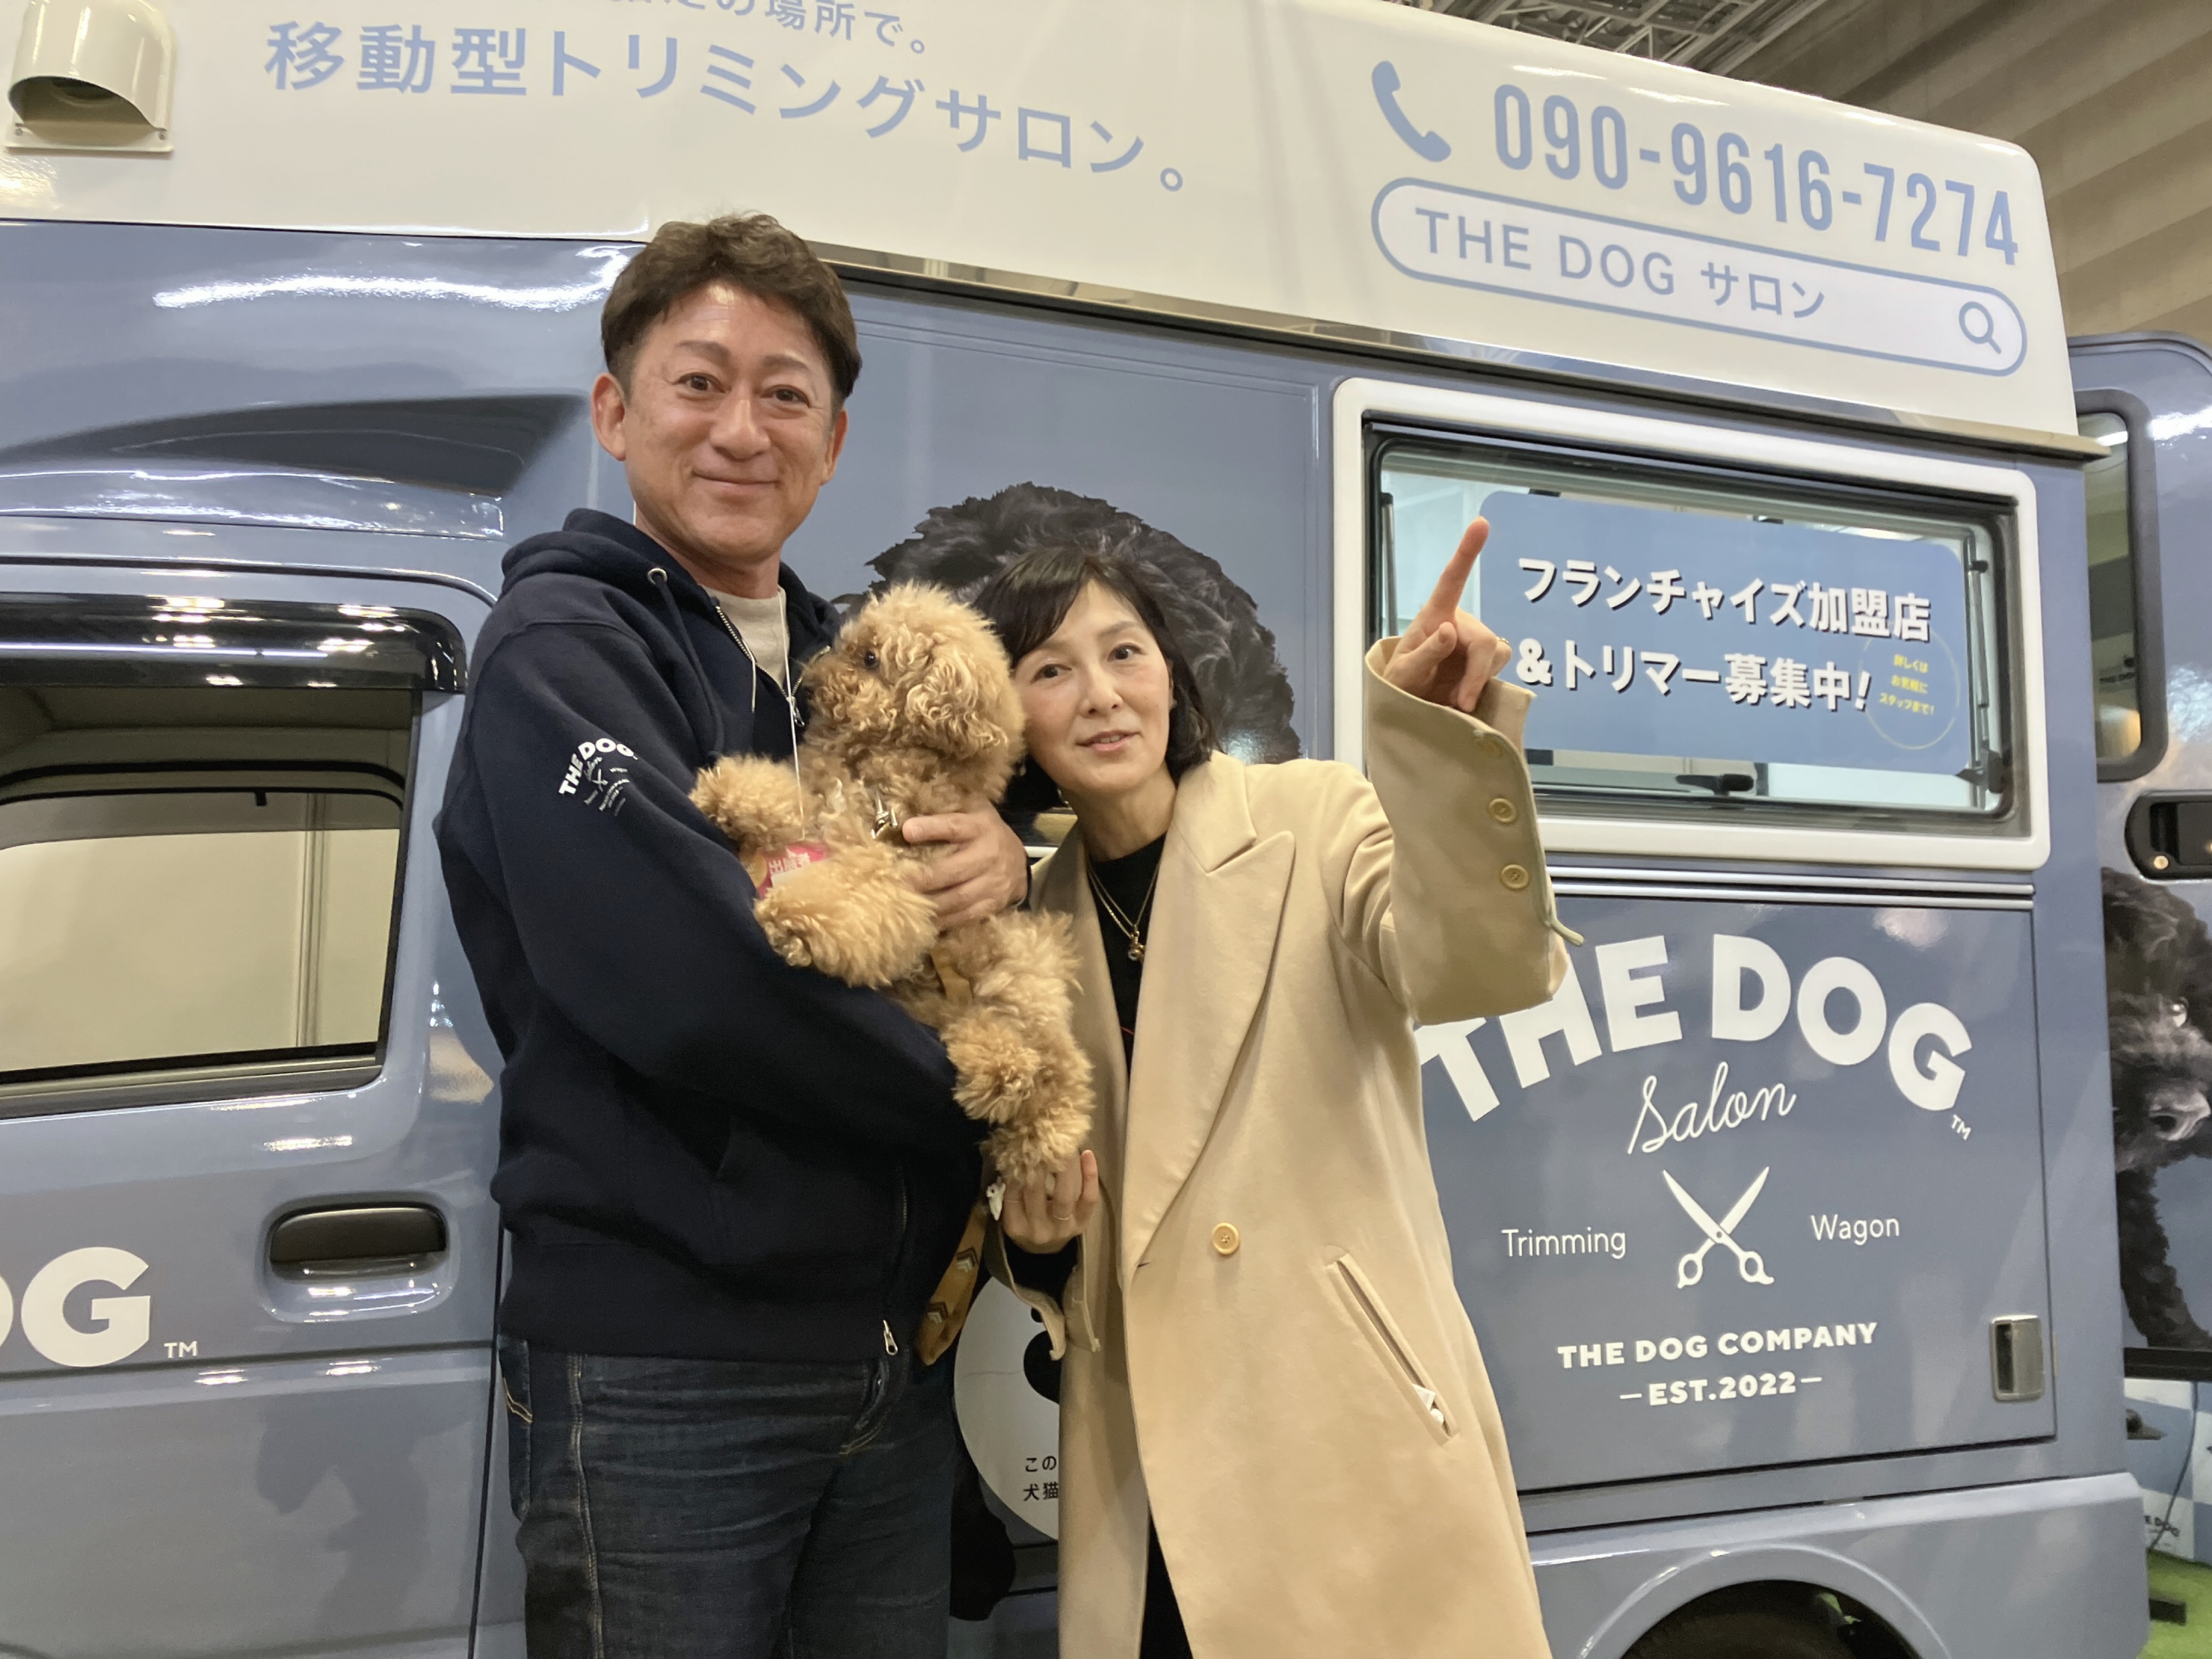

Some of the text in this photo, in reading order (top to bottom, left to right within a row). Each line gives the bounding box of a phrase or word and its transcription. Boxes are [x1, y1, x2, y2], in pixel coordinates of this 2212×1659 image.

[265, 20, 1184, 192] 移動型トリミングサロン。
[1494, 84, 2019, 266] 090-9616-7274
[1415, 207, 1826, 318] THE DOG サロン
[1518, 558, 1931, 643] フランチャイズ加盟店
[1516, 637, 1871, 711] &トリマー募集中!
[558, 753, 584, 795] THE
[578, 738, 634, 761] DOG
[1413, 934, 1973, 1141] THE DOG TM
[1627, 1061, 1797, 1155] Salon
[1501, 1227, 1627, 1259] Trimming
[1810, 1214, 1900, 1246] Wagon
[0, 1246, 197, 1367] G TM
[1556, 1322, 1878, 1369] THE DOG COMPANY
